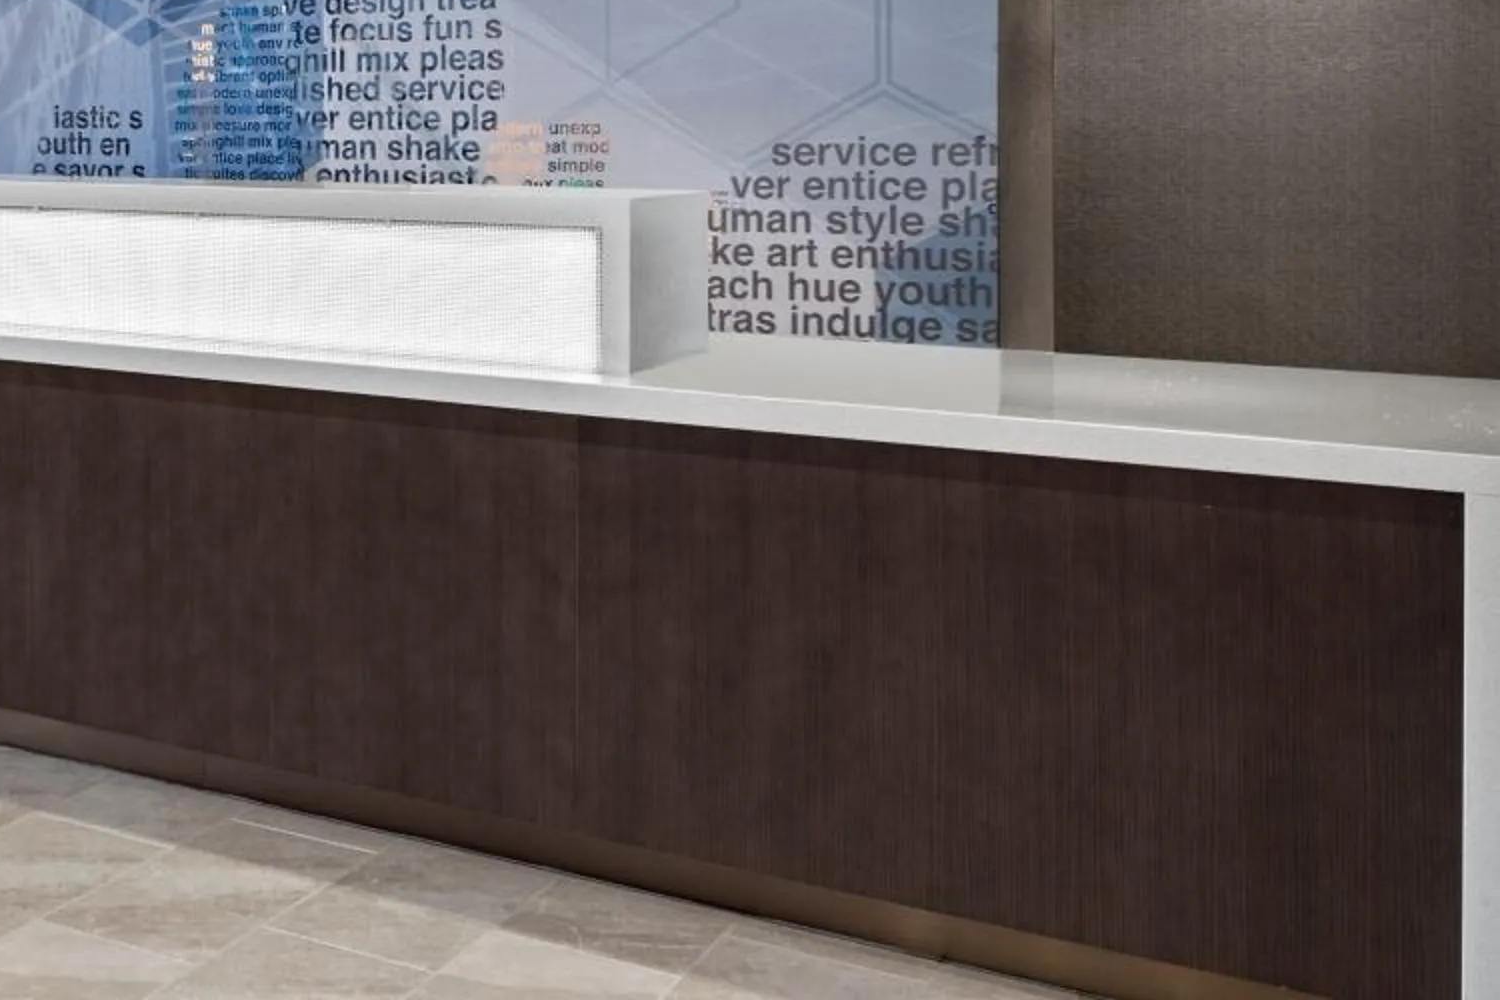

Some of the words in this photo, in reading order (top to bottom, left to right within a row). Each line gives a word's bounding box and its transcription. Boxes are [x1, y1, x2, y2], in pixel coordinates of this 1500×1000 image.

[330, 14, 413, 43] focus
[423, 14, 472, 41] fun
[484, 19, 503, 39] s
[357, 48, 409, 72] mix
[421, 44, 504, 78] pleas
[390, 74, 504, 102] service
[54, 105, 120, 129] iastic
[129, 110, 143, 129] s
[348, 104, 441, 132] entice
[452, 104, 498, 138] pla
[37, 132, 92, 155] outh
[100, 136, 131, 156] en
[387, 134, 481, 162] shake
[771, 136, 916, 167] service
[53, 161, 124, 177] savor
[731, 175, 790, 200] ver
[803, 170, 927, 201] entice
[942, 171, 998, 210] pla
[707, 208, 811, 233] uman
[826, 204, 924, 243] style
[710, 236, 754, 267] ke
[767, 239, 818, 268] art
[708, 270, 773, 301] ach
[789, 271, 861, 303] hue
[875, 276, 993, 308] youth
[708, 303, 776, 335] tras
[791, 306, 943, 344] indulge
